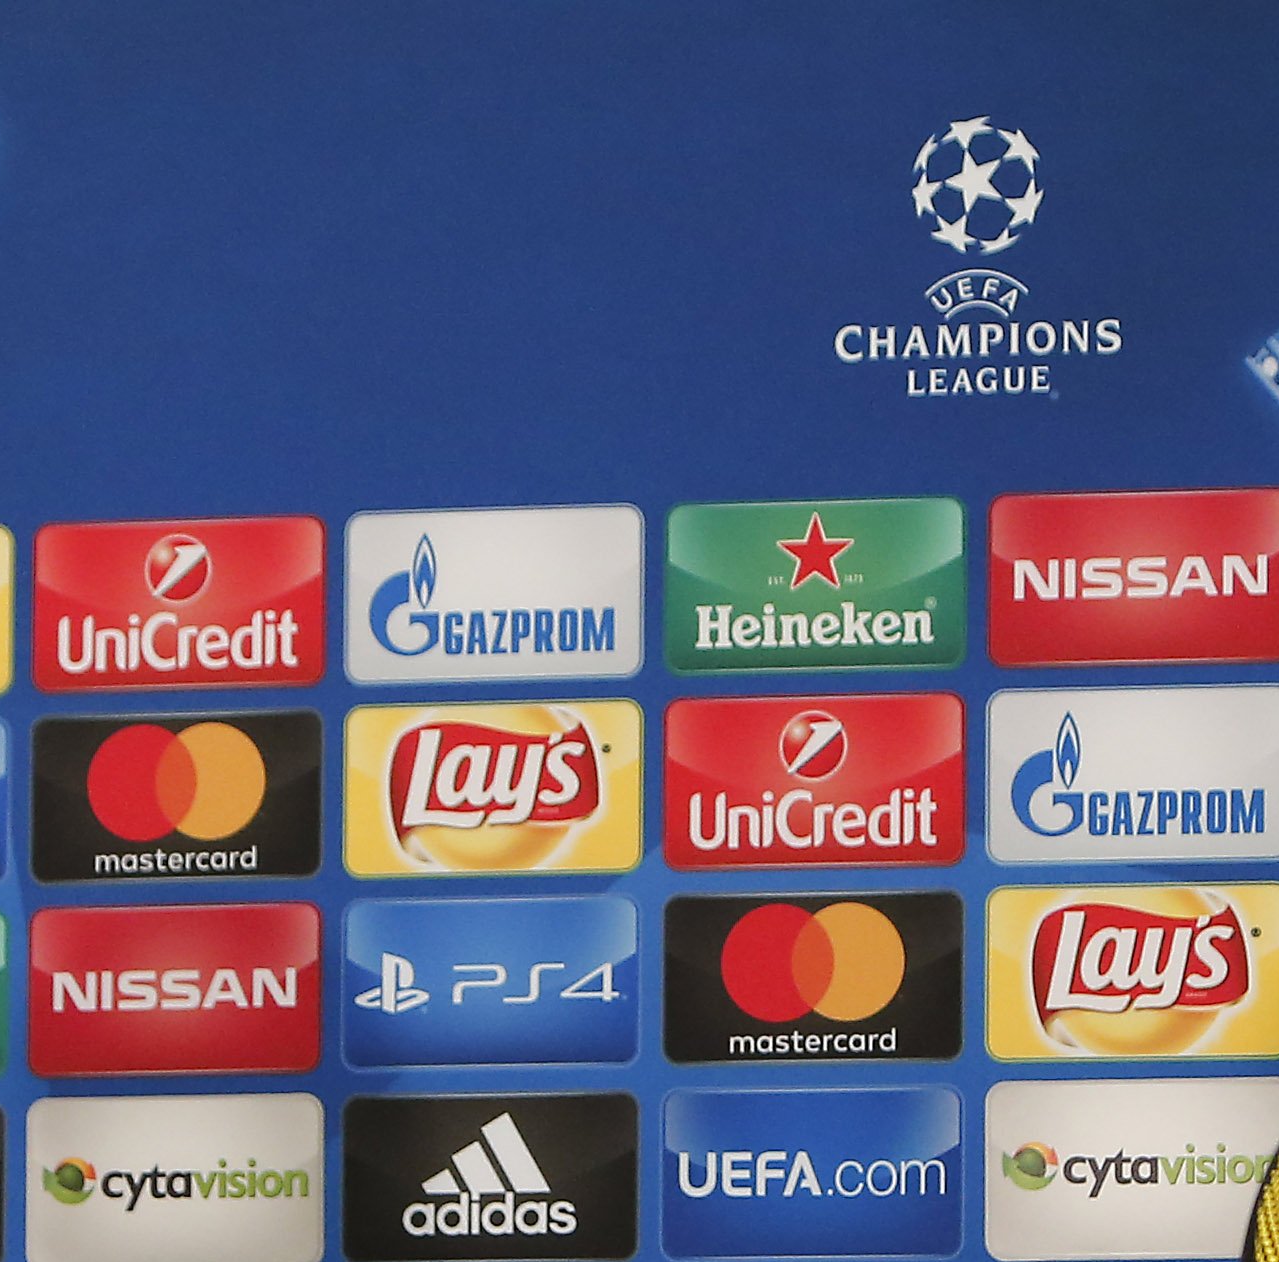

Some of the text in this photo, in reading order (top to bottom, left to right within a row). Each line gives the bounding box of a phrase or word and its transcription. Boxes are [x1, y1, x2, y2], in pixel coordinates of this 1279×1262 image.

[930, 277, 1019, 313] UEFA
[833, 318, 1122, 363] CHAMPIONS
[907, 365, 1051, 397] LEAGUE
[1012, 554, 1269, 602] NISSAN
[56, 609, 300, 673] UniCredit
[443, 608, 616, 655] GAZPROM
[694, 601, 935, 650] Heineken
[401, 727, 587, 829] Lay's
[687, 787, 938, 850] UniCredit
[1087, 788, 1266, 836] GAZPROM
[93, 846, 258, 875] mastercard
[452, 962, 620, 1004] PS4
[1045, 910, 1234, 1013] Lay's
[51, 967, 298, 1013] NISSAN
[728, 1028, 897, 1056] mastercard
[101, 1157, 310, 1211] cytavision
[677, 1148, 947, 1198] UEFA.com
[401, 1191, 579, 1237] adidas
